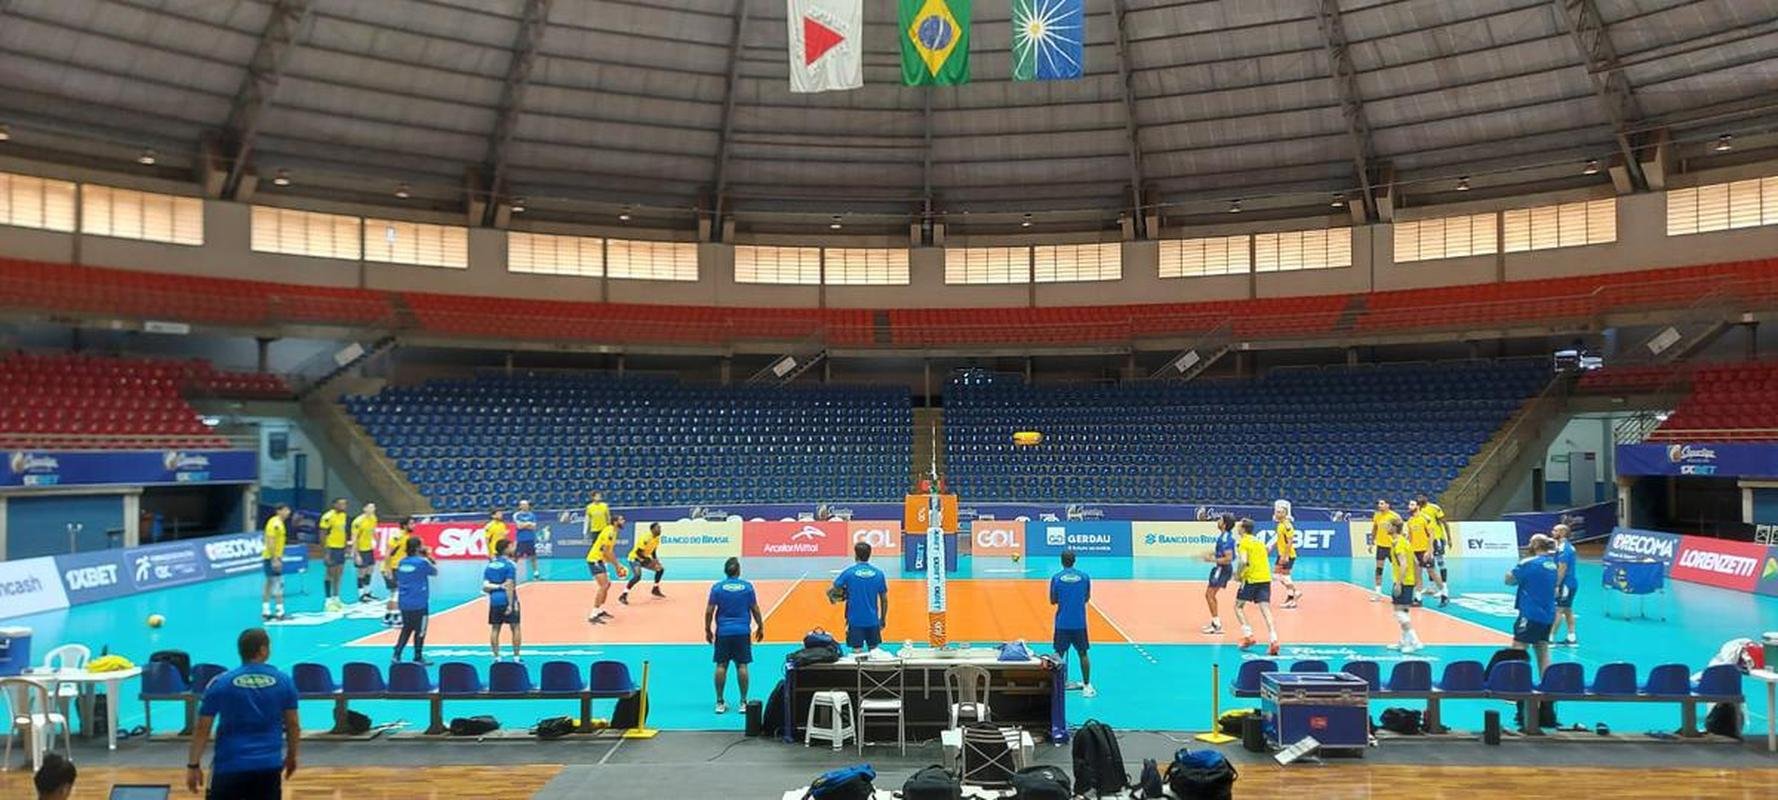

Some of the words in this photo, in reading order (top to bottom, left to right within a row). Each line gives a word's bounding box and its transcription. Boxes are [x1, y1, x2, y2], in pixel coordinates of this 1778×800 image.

[660, 535, 688, 545] BANCO
[702, 535, 729, 545] BRASIL
[853, 529, 896, 548] GOL
[977, 529, 1021, 548] GOL
[1067, 534, 1111, 544] GERDAU
[1159, 535, 1188, 544] BANCO
[1201, 535, 1217, 544] BRA
[1468, 538, 1484, 549] EY
[764, 543, 819, 553] ArcelorMittal
[1624, 535, 1673, 558] RECOMA
[1679, 549, 1759, 577] LORENZETTI
[65, 564, 118, 591] 1XBET
